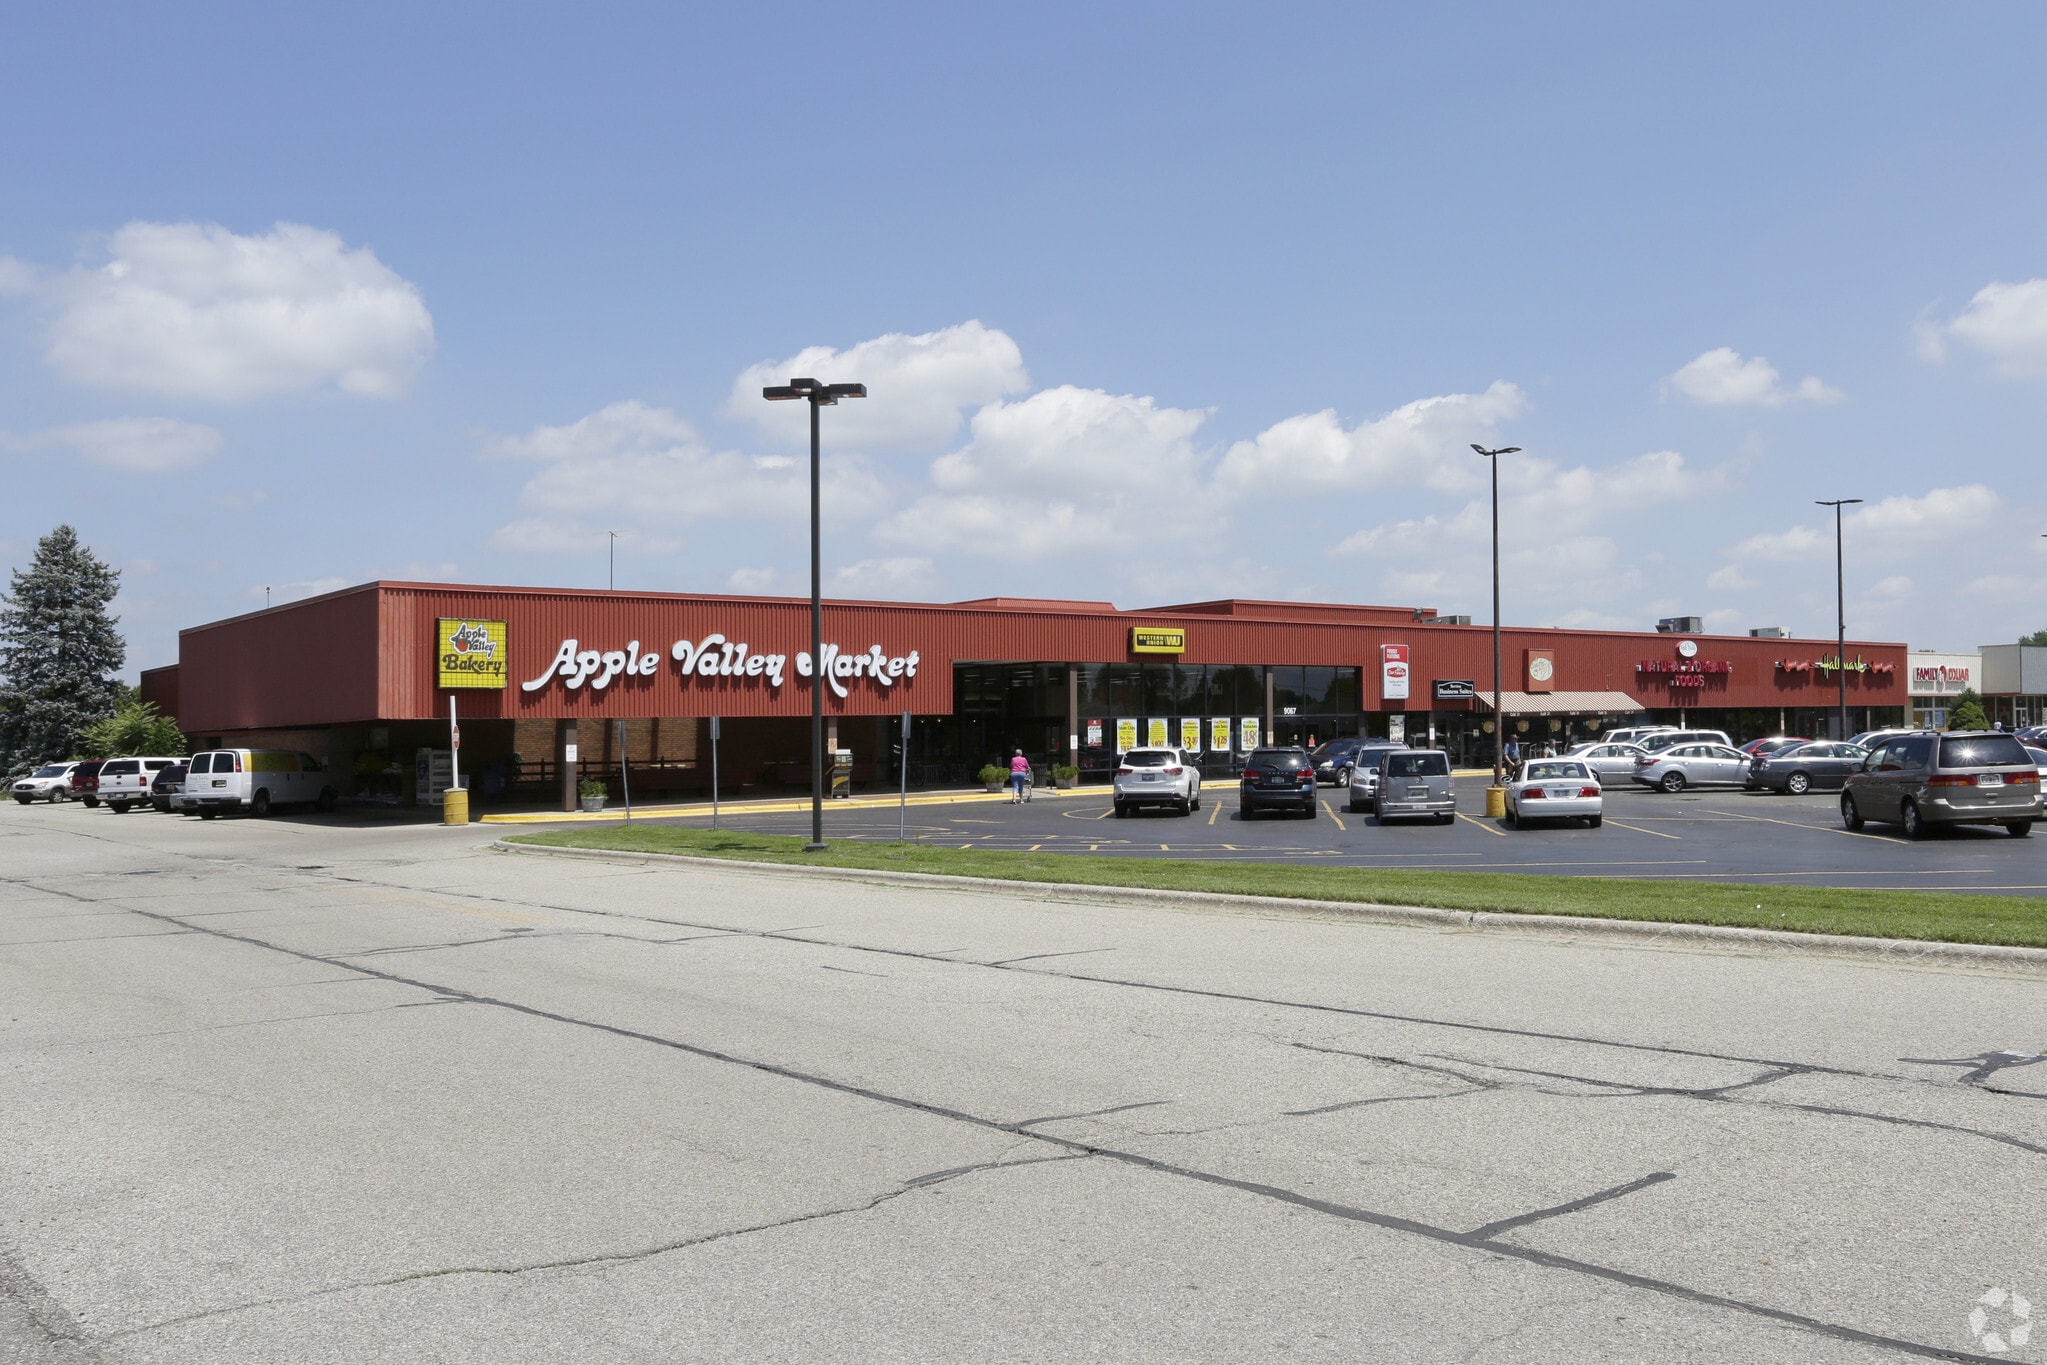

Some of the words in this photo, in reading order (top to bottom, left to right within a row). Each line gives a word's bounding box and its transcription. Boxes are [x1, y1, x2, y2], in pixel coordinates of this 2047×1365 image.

[456, 623, 488, 642] Apple
[468, 639, 497, 658] Valley
[442, 653, 503, 678] Bakery
[521, 638, 660, 692] Apple
[671, 633, 786, 687] Valley
[795, 642, 920, 698] Market
[1916, 667, 1939, 681] FAMILY
[1675, 675, 1705, 687] FOODS
